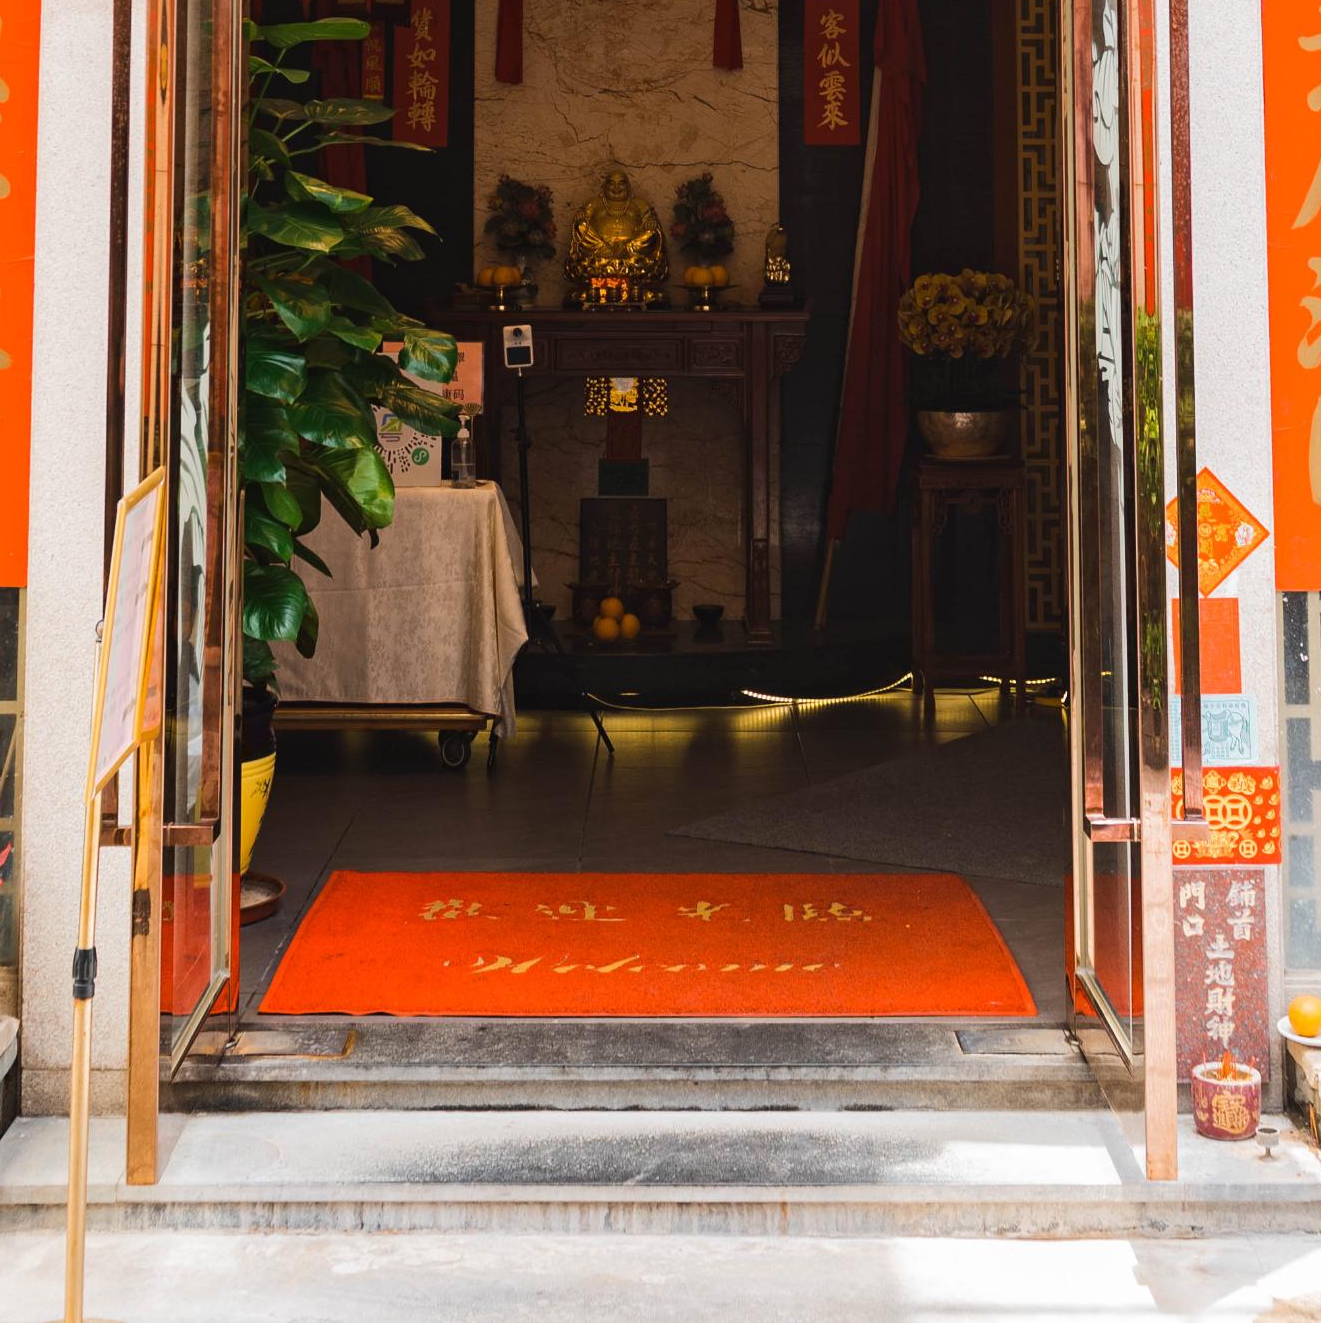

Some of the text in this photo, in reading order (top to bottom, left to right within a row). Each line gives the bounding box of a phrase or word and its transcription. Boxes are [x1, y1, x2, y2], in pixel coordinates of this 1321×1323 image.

[406, 7, 439, 132] 貨如輪轉
[816, 7, 851, 131] 客似雲來
[1180, 881, 1206, 936] 門口
[1204, 934, 1236, 1050] 土地財神
